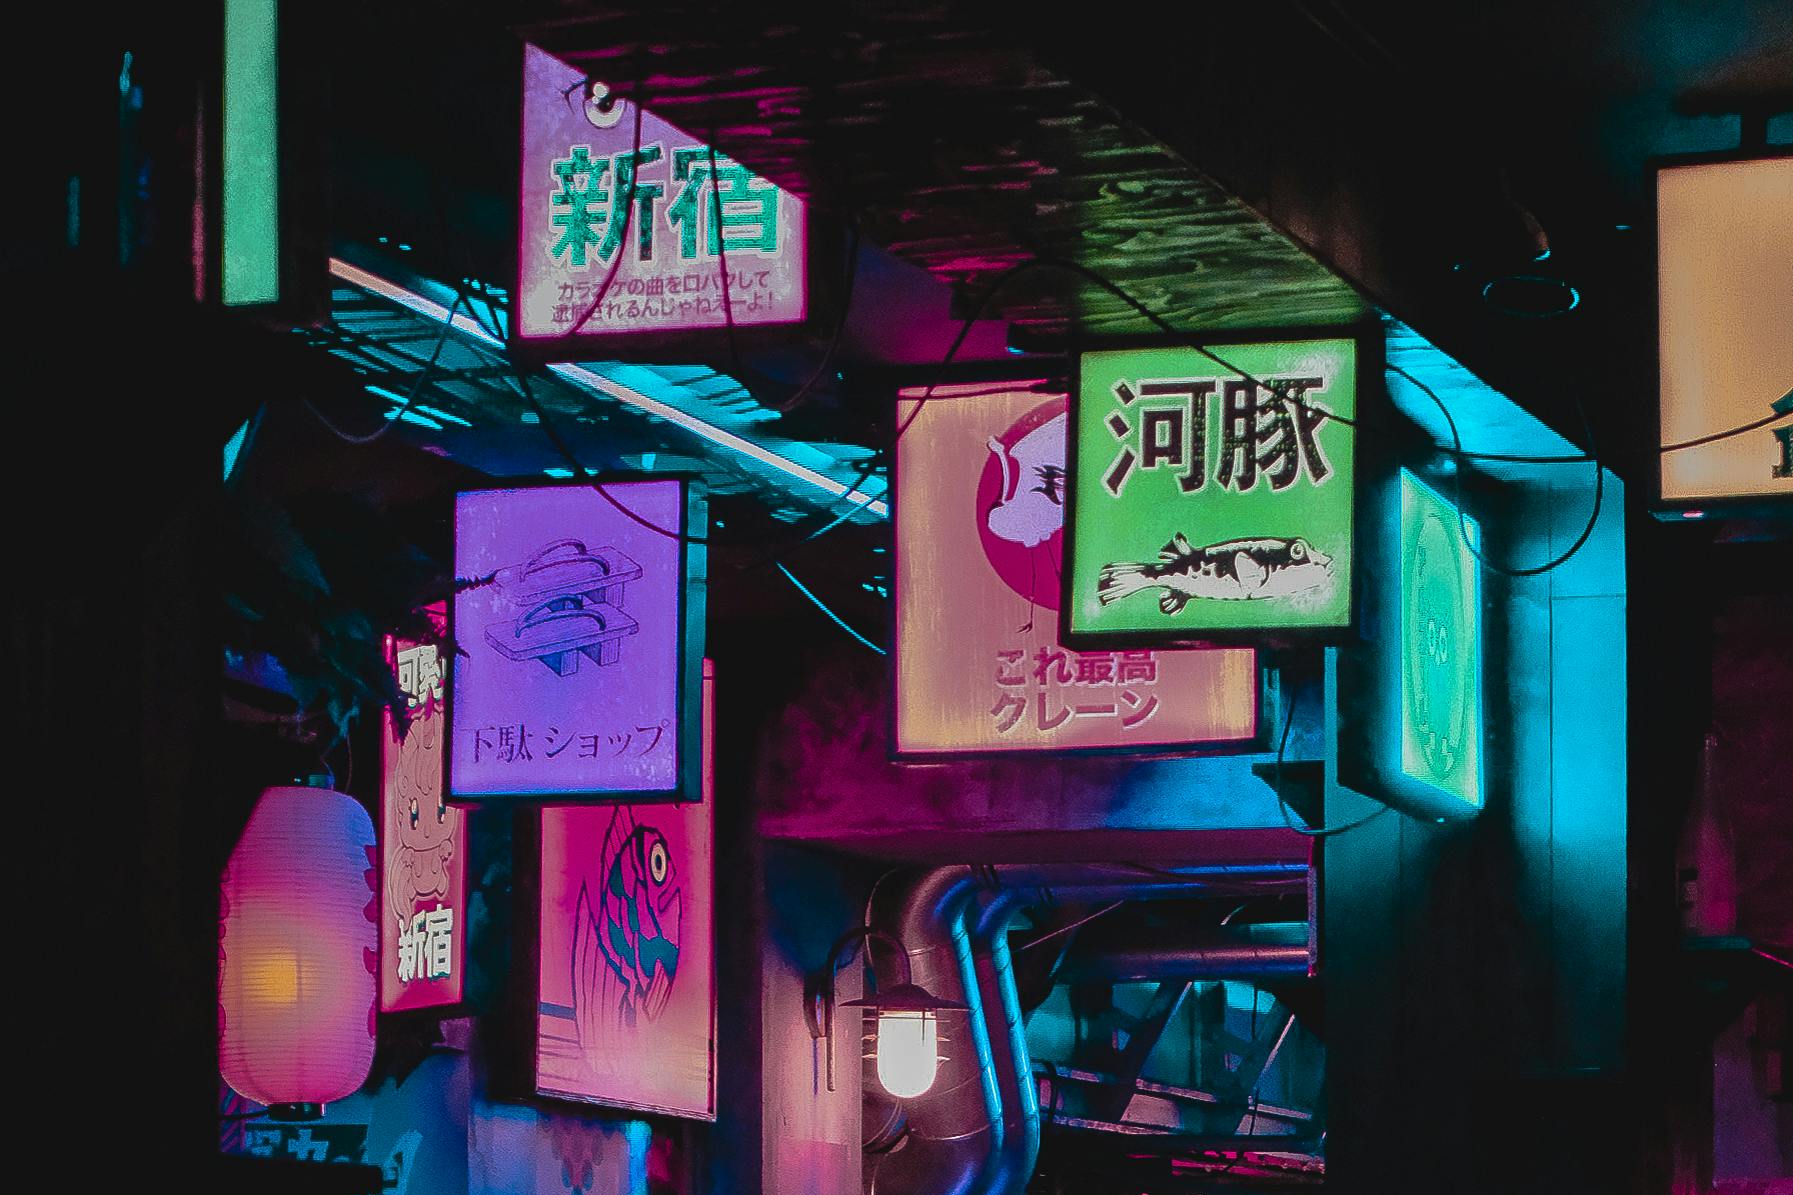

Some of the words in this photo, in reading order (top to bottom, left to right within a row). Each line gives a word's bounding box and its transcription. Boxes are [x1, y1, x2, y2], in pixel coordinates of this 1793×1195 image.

[549, 145, 781, 266] 新宿
[1103, 375, 1333, 495] 河豚
[992, 645, 1158, 687] これ最高
[460, 718, 671, 764] 下駄ショップ
[989, 688, 1161, 734] クレーン
[397, 903, 454, 983] 新宿
